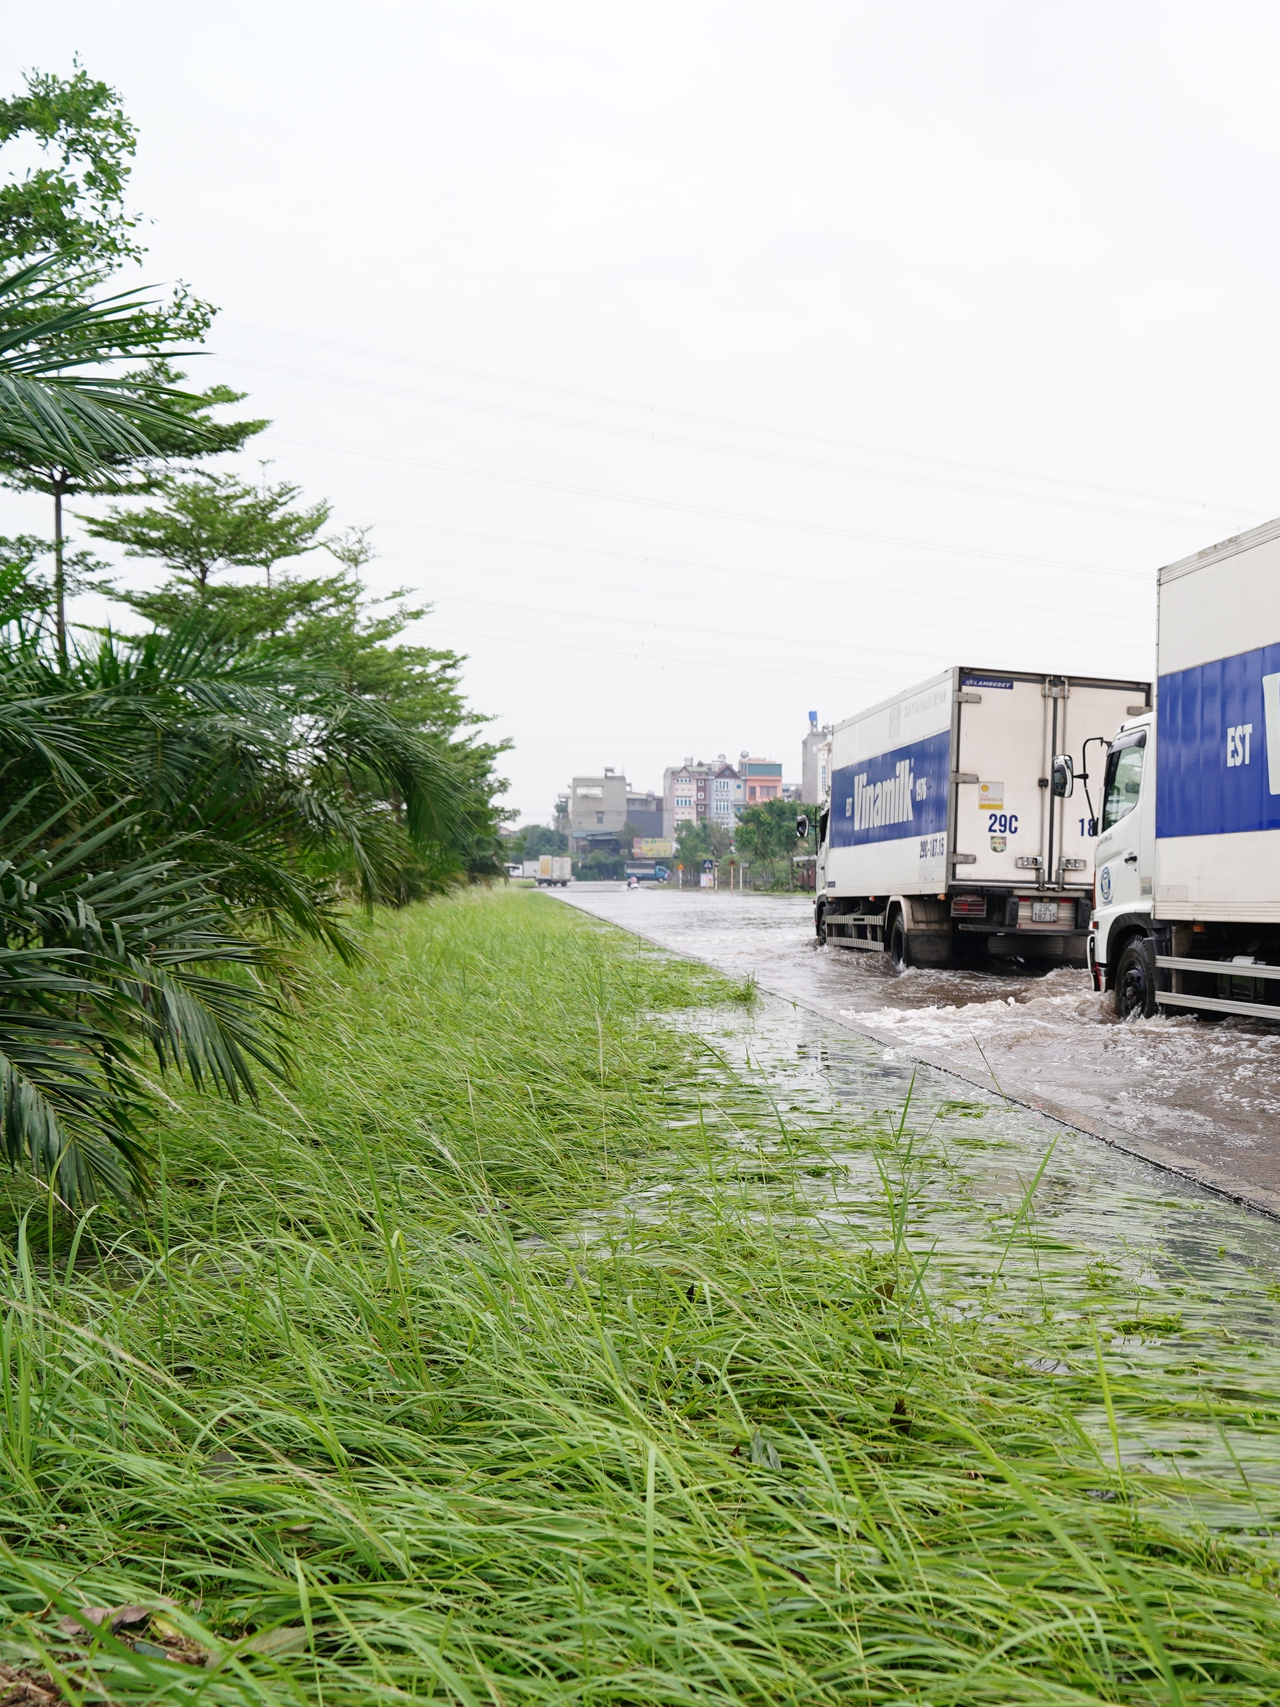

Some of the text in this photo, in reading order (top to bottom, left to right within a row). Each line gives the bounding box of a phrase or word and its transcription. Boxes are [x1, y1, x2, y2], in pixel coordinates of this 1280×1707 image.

[973, 680, 1011, 688] LAMBERET
[1226, 723, 1252, 768] EST
[854, 758, 914, 831] Vinamilk
[987, 813, 1019, 834] 29C
[1039, 903, 1053, 912] 29C
[1034, 912, 1057, 921] 187.15
